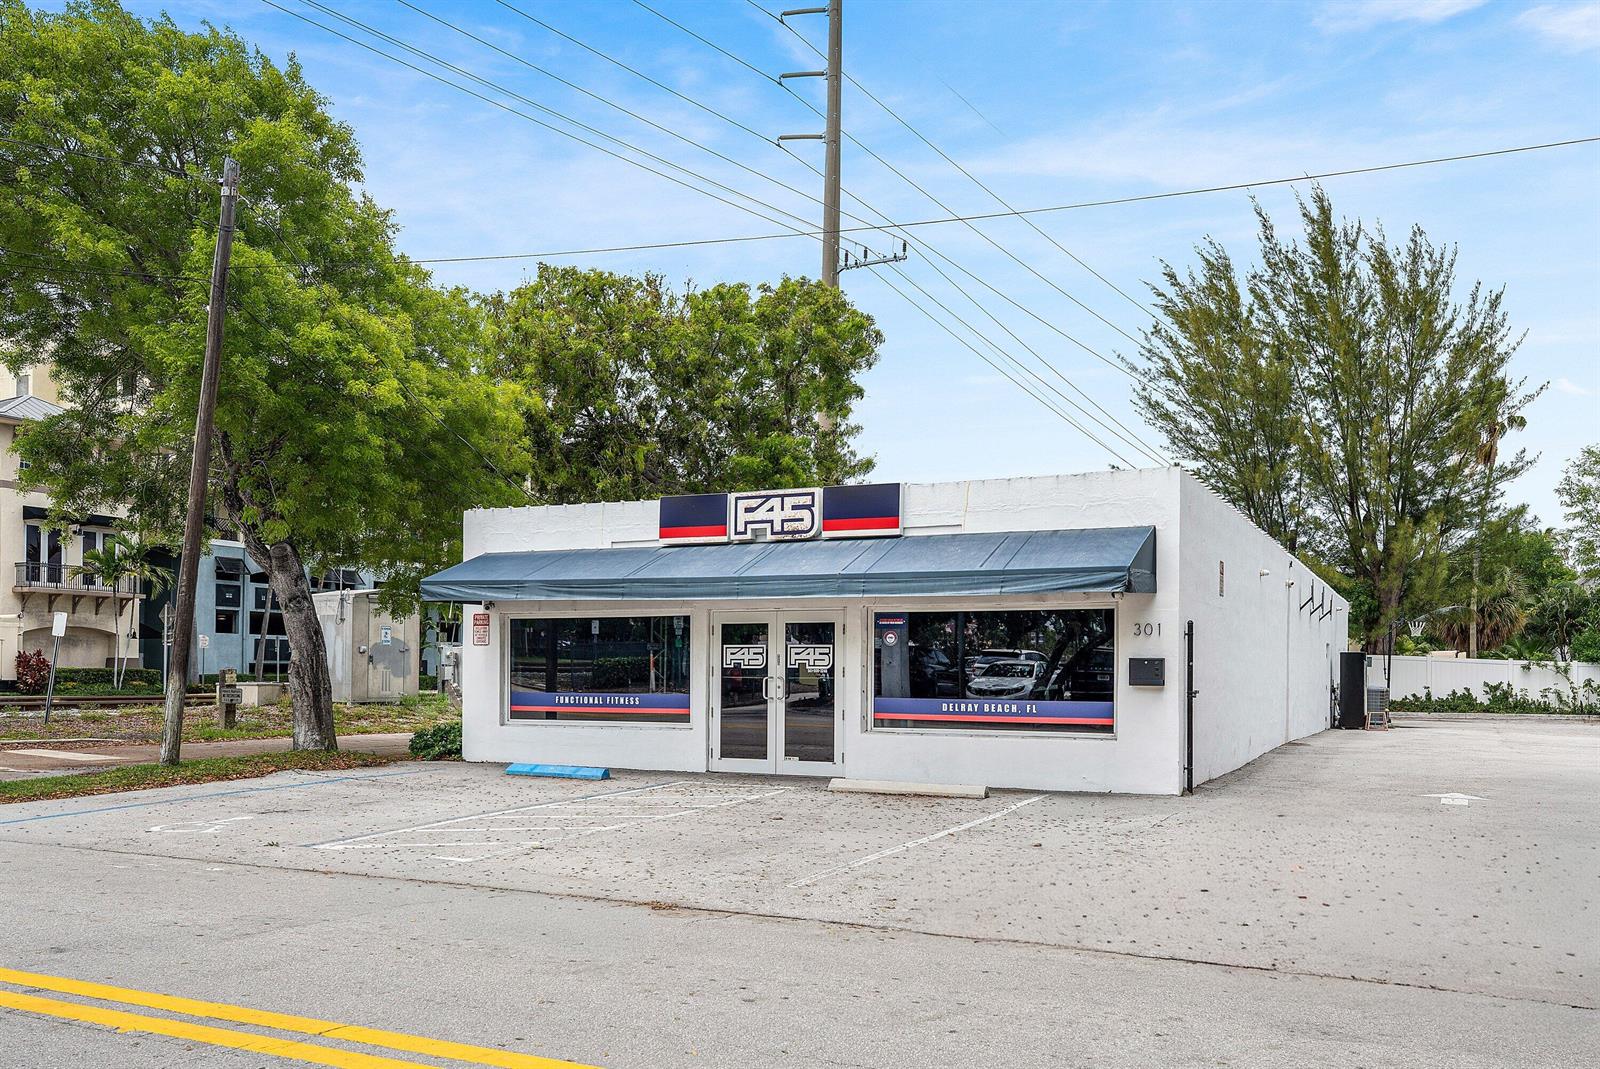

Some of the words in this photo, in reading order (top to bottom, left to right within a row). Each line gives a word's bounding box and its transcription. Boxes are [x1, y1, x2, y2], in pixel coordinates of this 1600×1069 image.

[735, 492, 815, 535] F45
[1133, 623, 1161, 636] 301
[724, 646, 765, 667] F45
[789, 646, 831, 667] F45
[555, 696, 603, 704] FUNCTIONAL
[606, 697, 640, 705] FITNESS
[942, 703, 979, 712] DELRAY
[984, 704, 1021, 713] BEACH,
[1026, 704, 1037, 713] FL
